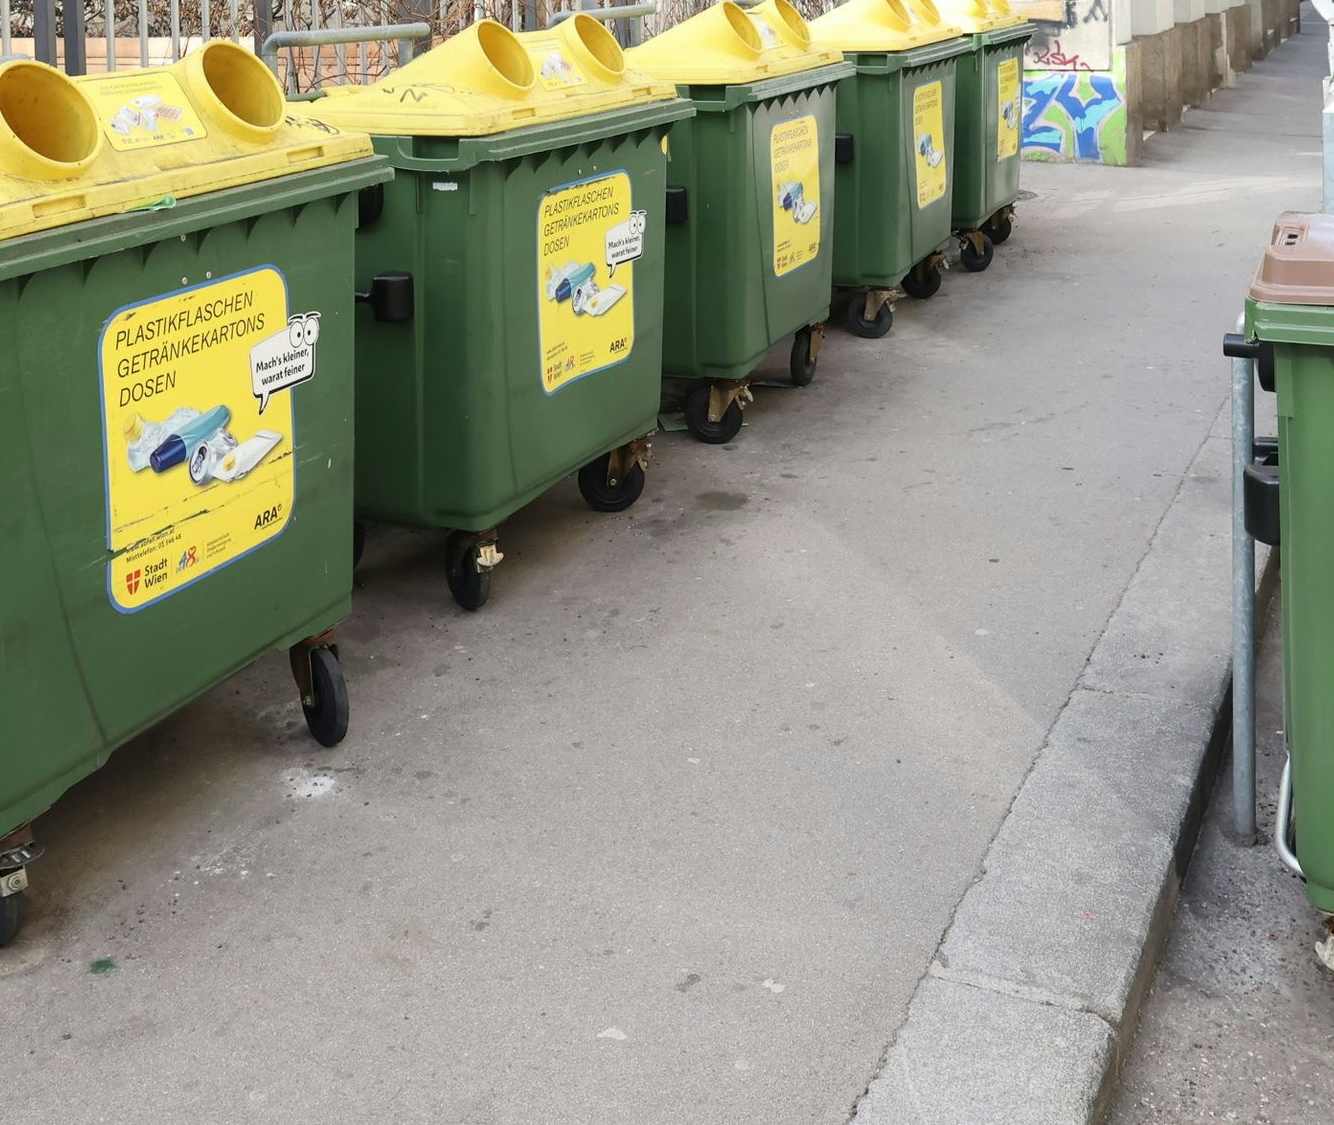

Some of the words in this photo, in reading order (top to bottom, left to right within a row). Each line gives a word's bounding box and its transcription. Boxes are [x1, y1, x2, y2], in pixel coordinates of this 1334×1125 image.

[544, 185, 614, 219] PLASTIKFLASCHEN
[544, 202, 620, 237] GETRÄNKEKARTONS
[544, 235, 571, 256] DOSEN
[115, 290, 254, 351] PLASTIKFLASCHEN
[117, 313, 265, 378] GETRÄNKEKARTONS
[256, 352, 283, 373] Mach's
[283, 347, 310, 365] kleiner,
[261, 369, 283, 386] warat
[283, 362, 306, 379] feiner
[119, 370, 176, 408] DOSEN
[254, 506, 278, 531] ARA
[144, 558, 168, 577] Stadt
[144, 572, 168, 589] Wien
